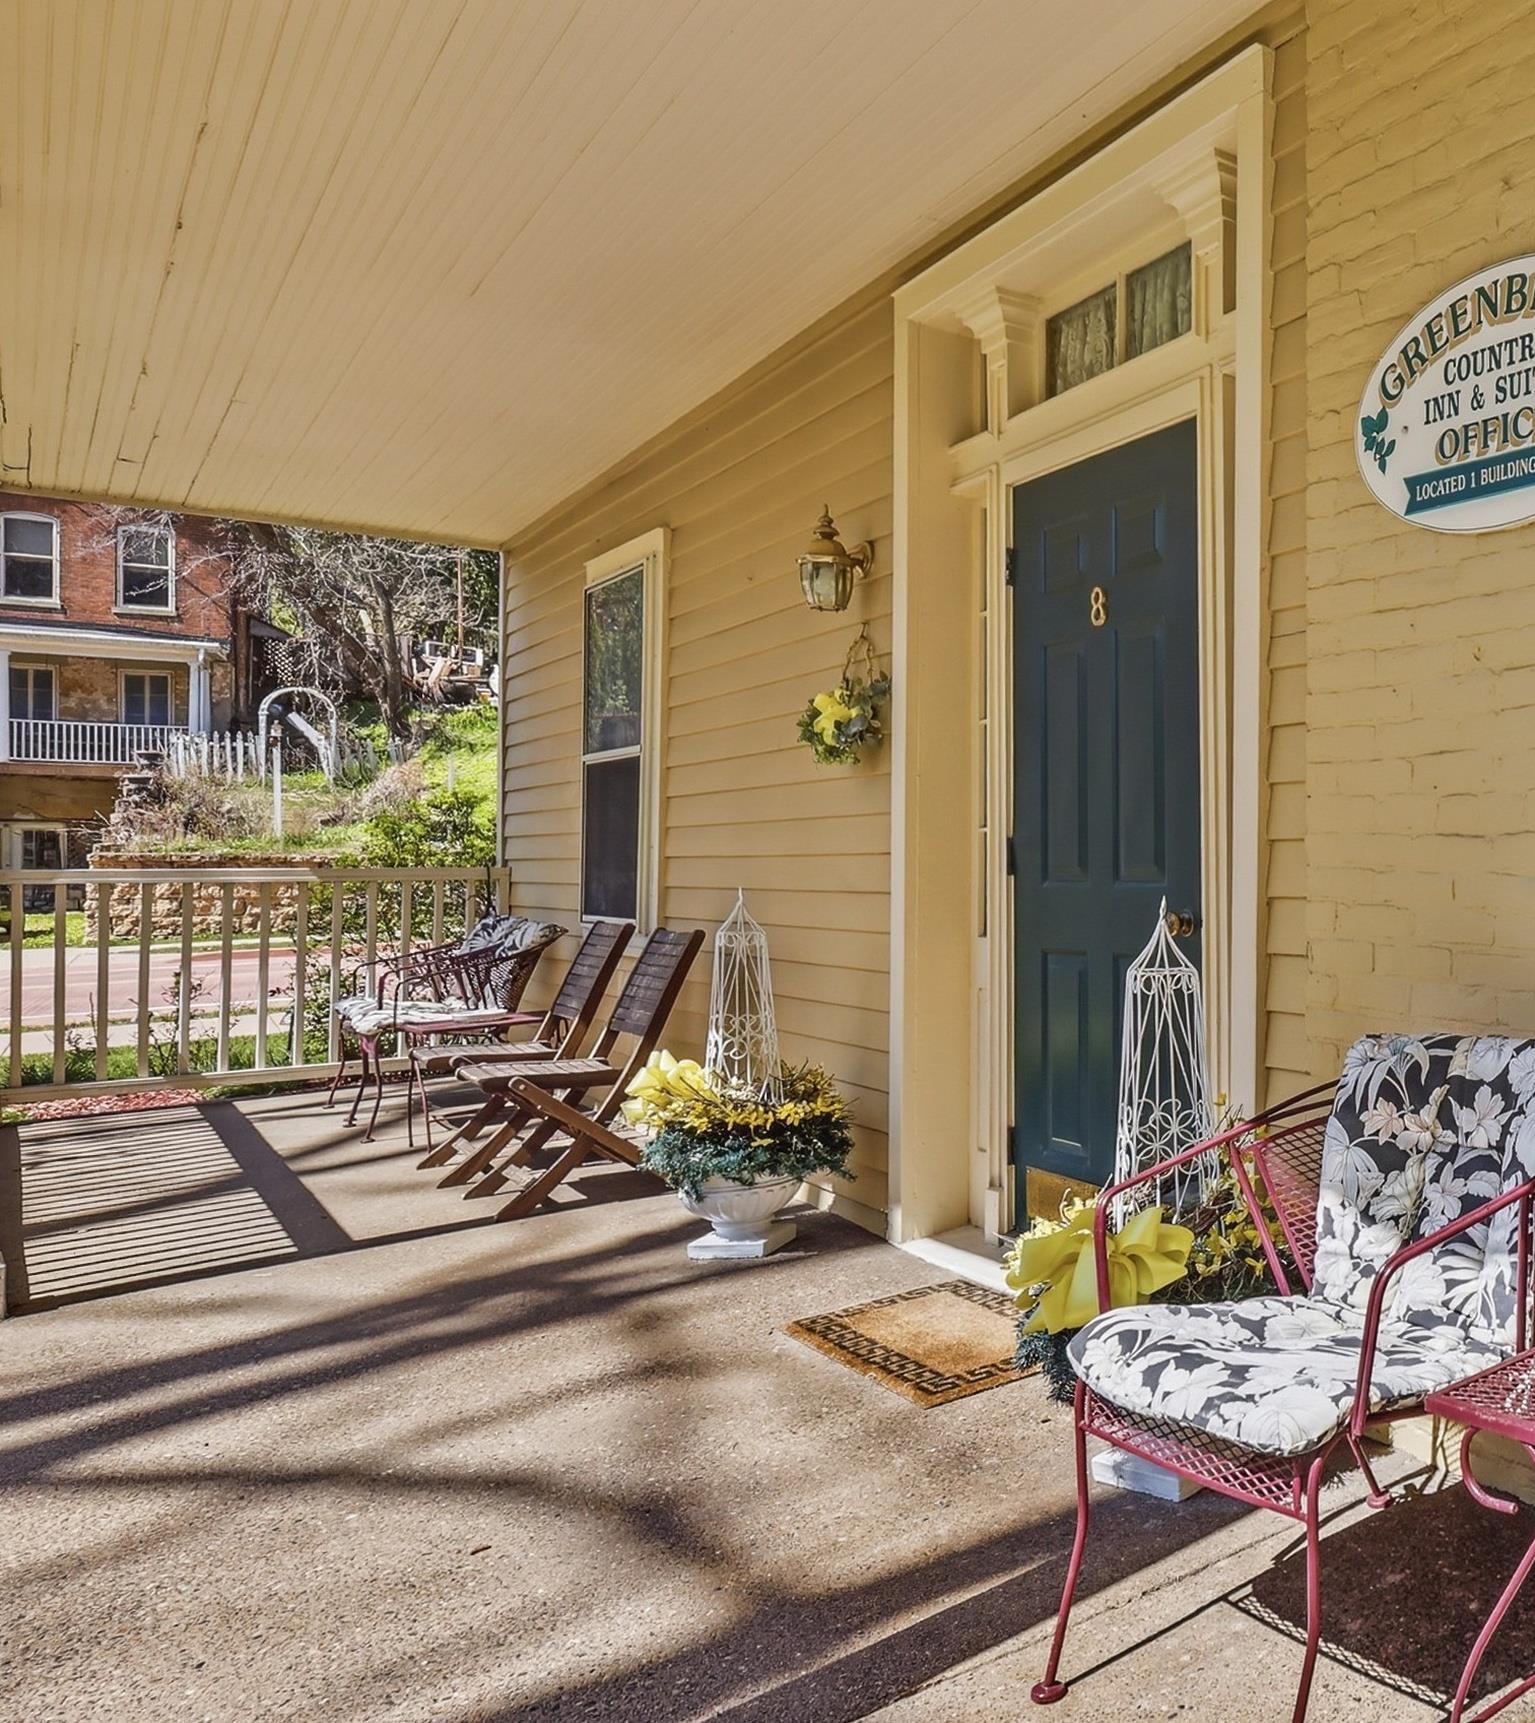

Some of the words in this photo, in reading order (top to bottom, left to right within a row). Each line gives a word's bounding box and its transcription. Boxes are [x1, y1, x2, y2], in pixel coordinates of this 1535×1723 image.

[1424, 390, 1460, 425] INN
[1470, 383, 1486, 411] &
[1416, 475, 1465, 501] LOCATED
[1470, 471, 1477, 489] 1
[1090, 586, 1106, 627] 8
